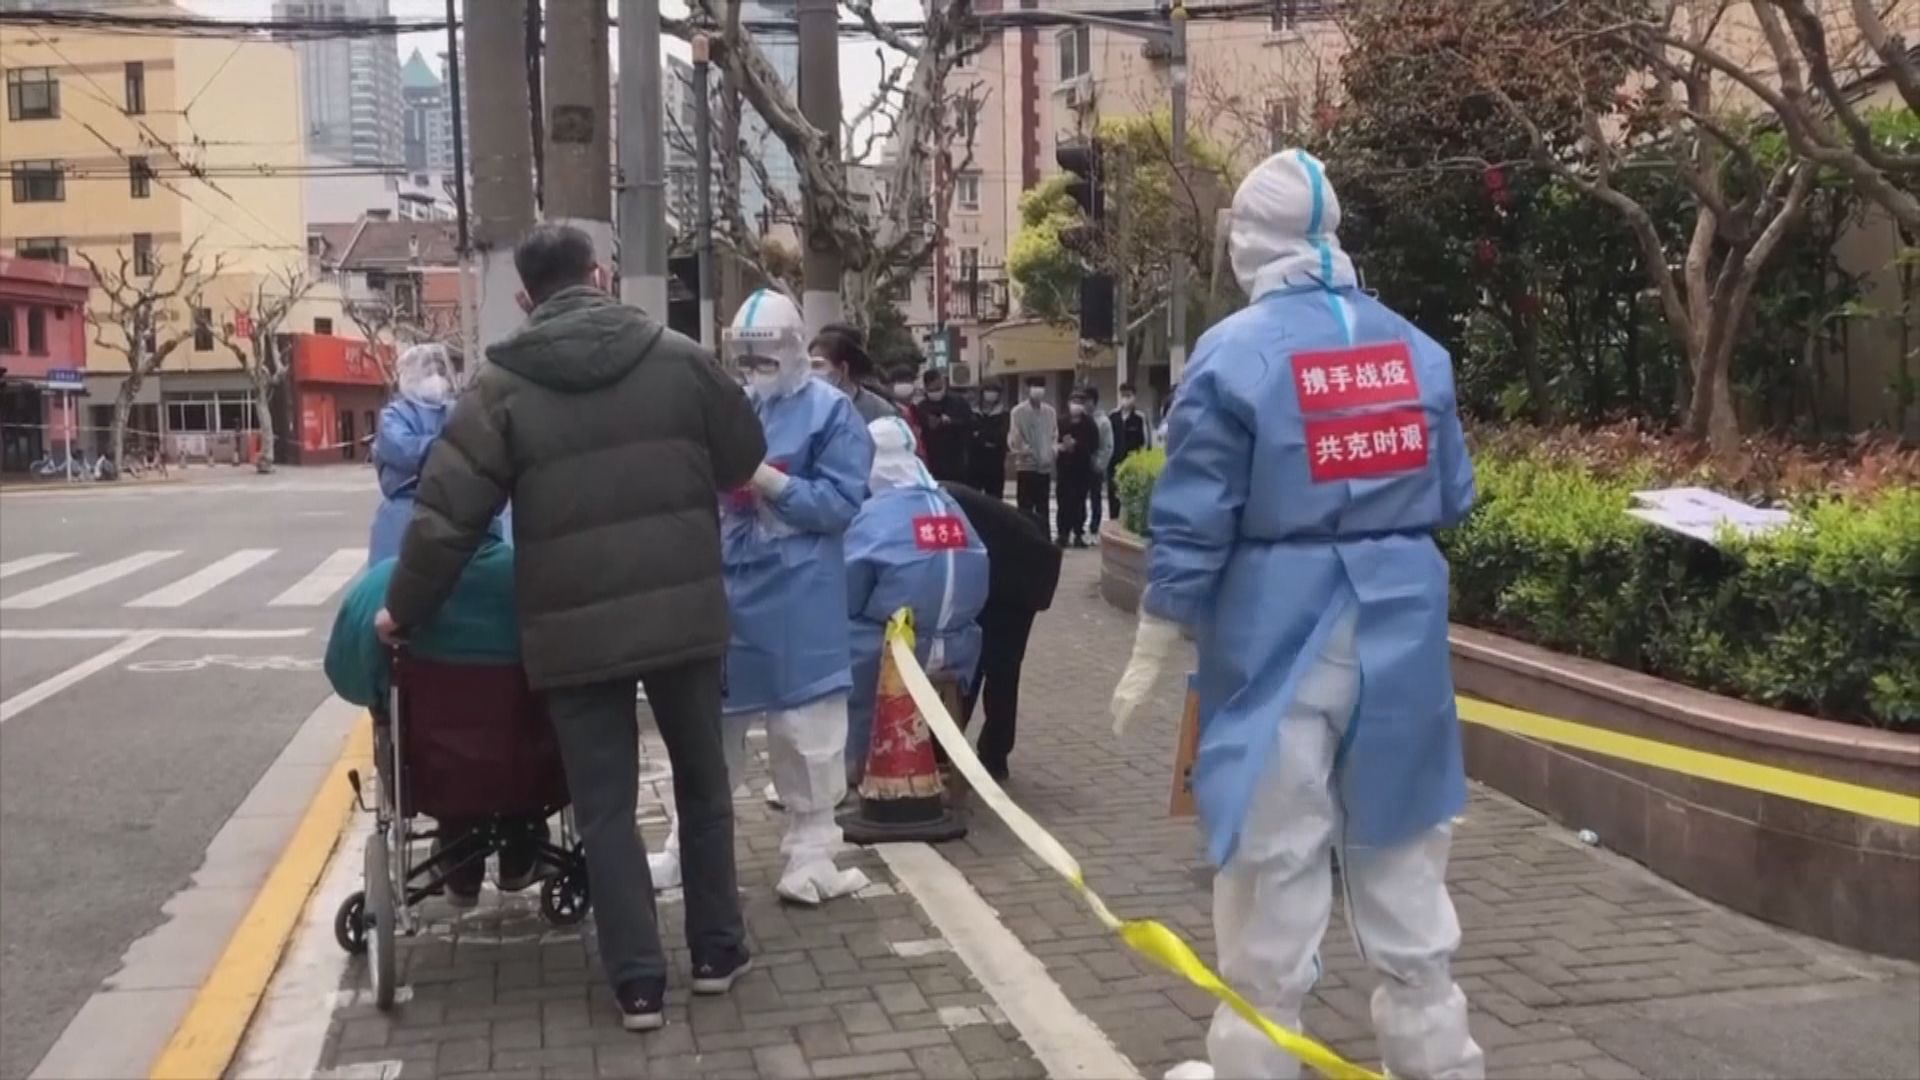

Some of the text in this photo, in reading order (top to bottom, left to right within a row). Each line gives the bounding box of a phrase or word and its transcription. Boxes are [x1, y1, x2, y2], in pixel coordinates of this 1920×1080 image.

[1301, 359, 1411, 395] 携手战疫
[1315, 423, 1423, 465] 共克时艰
